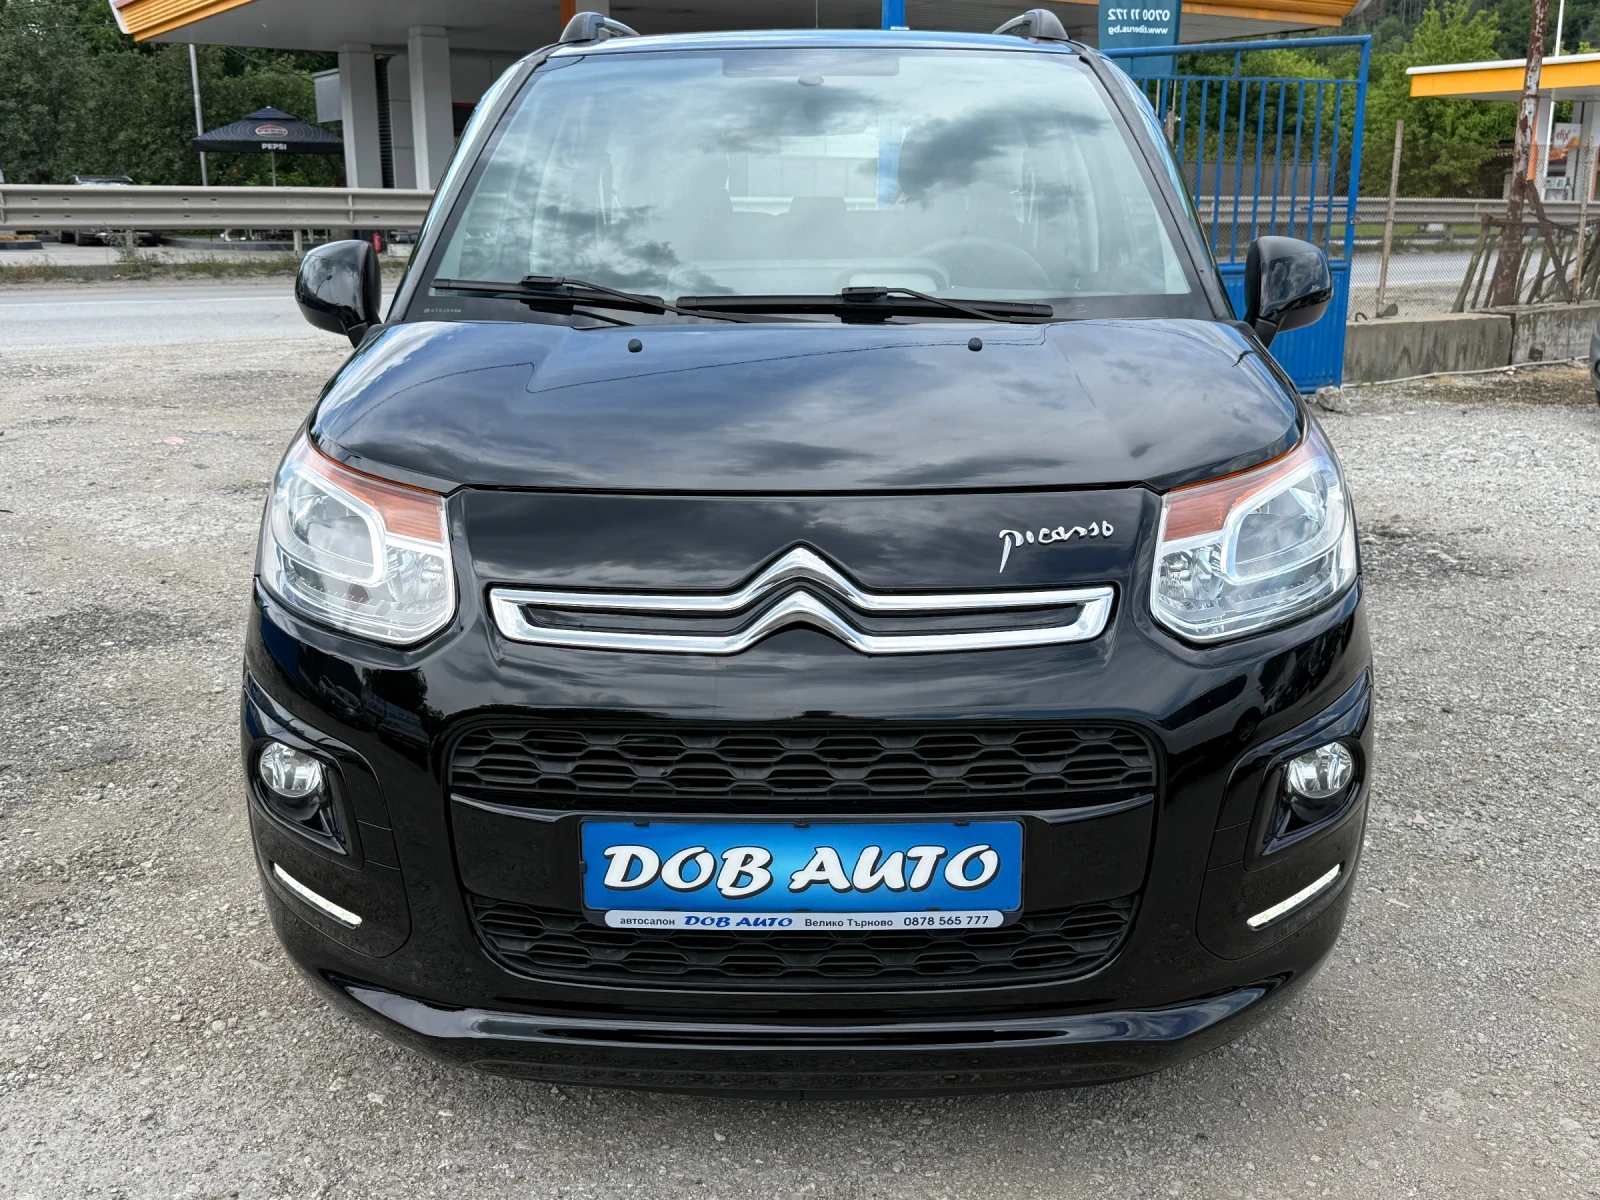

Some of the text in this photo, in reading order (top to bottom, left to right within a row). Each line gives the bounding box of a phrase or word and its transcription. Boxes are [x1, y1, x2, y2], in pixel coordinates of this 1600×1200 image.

[603, 843, 1000, 899] DOB AUTO
[620, 915, 989, 928] автосалон DOB AUTO Велико Търново 0878 565 777
